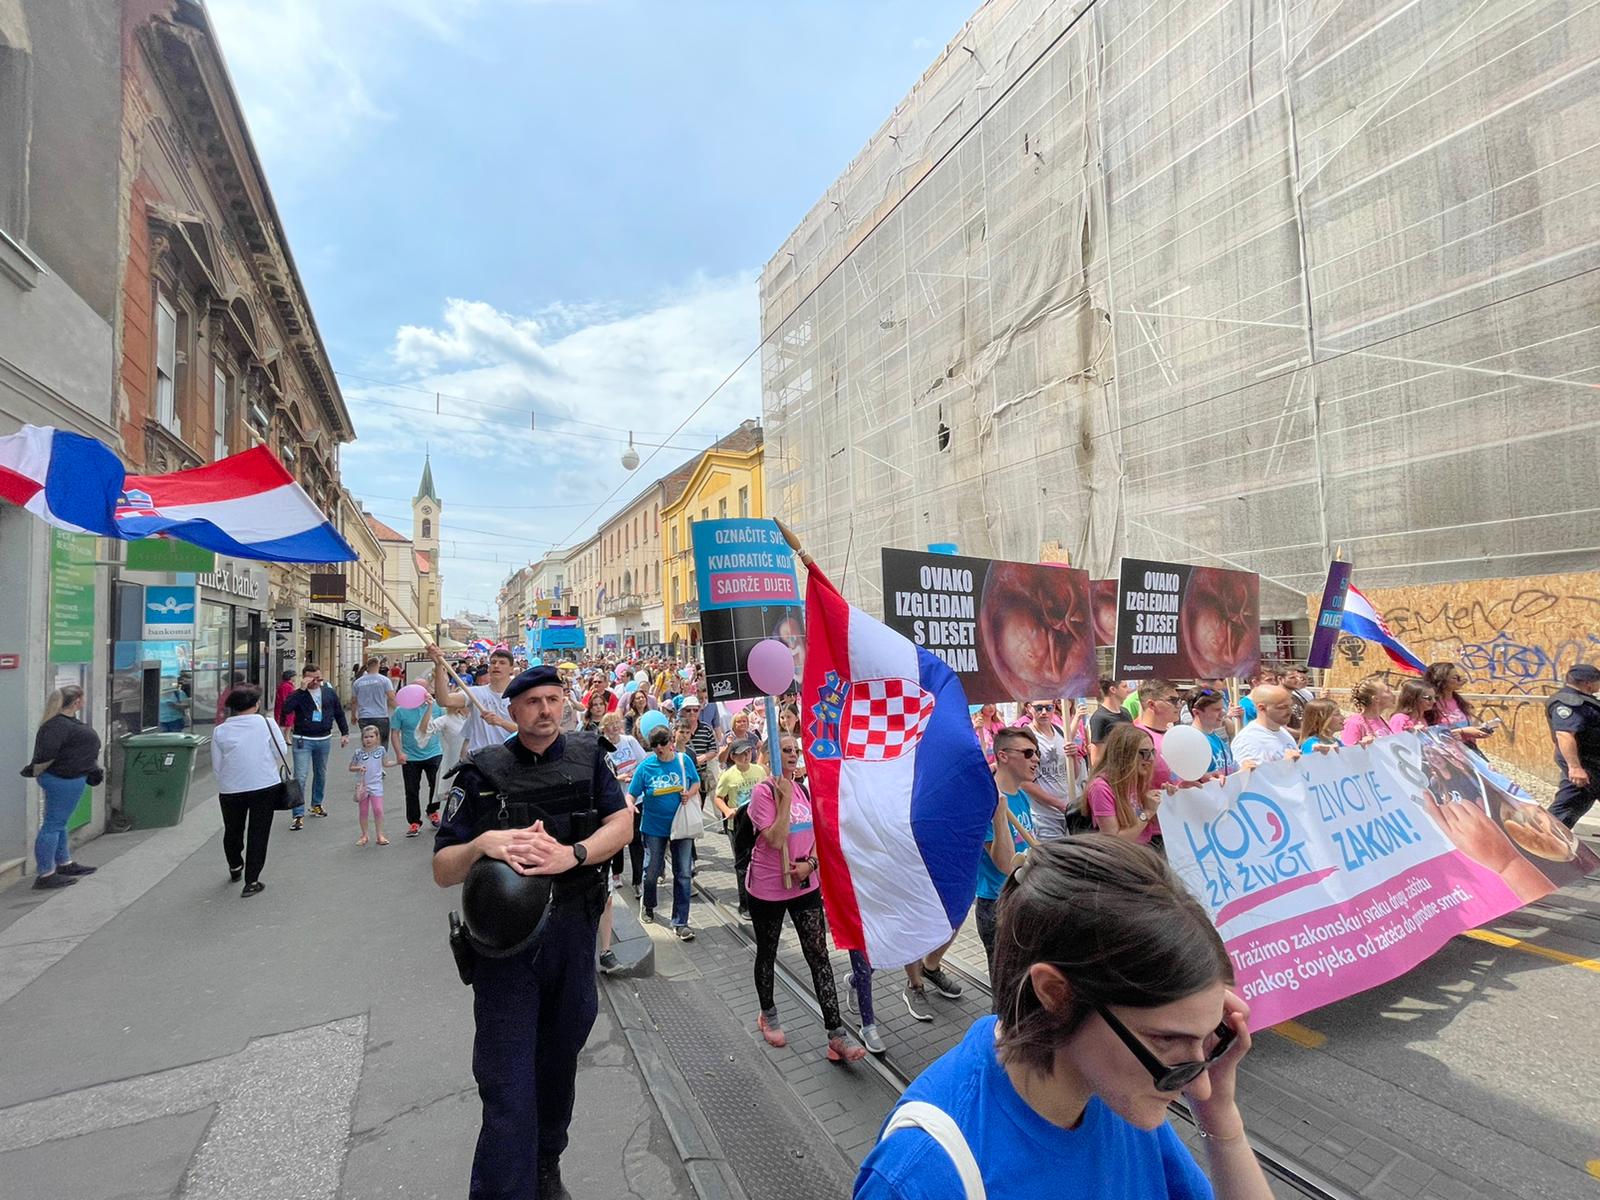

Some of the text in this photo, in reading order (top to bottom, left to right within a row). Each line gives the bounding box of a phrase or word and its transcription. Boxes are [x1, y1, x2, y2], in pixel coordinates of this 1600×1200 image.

[715, 526, 767, 545] OZNAČITE
[708, 551, 774, 570] KVADRATIĆE
[232, 561, 259, 599] banka
[717, 575, 792, 595] SADRŽE DIJETE
[920, 565, 974, 593] OVAKO
[1144, 571, 1180, 593] OVAKO
[895, 591, 975, 619] IZGLEDAM
[1126, 591, 1179, 613] IZGLEDAM
[148, 627, 192, 636] bankomat
[913, 620, 976, 645] S DESET
[1136, 613, 1179, 634] S DESET
[1131, 634, 1178, 655] TJEDANA
[1301, 770, 1393, 822] ŽIVOT JE
[1183, 791, 1291, 882] HOD
[1331, 808, 1422, 872] ZAKON!
[1206, 840, 1313, 907] ZA ŽIVOT
[1230, 939, 1290, 971] Tražimo
[1290, 913, 1362, 949] zakonsku
[1363, 898, 1393, 923] svaku
[1242, 970, 1300, 1000] svakog
[1294, 945, 1357, 978] čovjeka
[1356, 934, 1377, 958] od
[1374, 920, 1407, 951] začeća
[1401, 914, 1417, 934] do
[1437, 884, 1473, 911] smrti.
